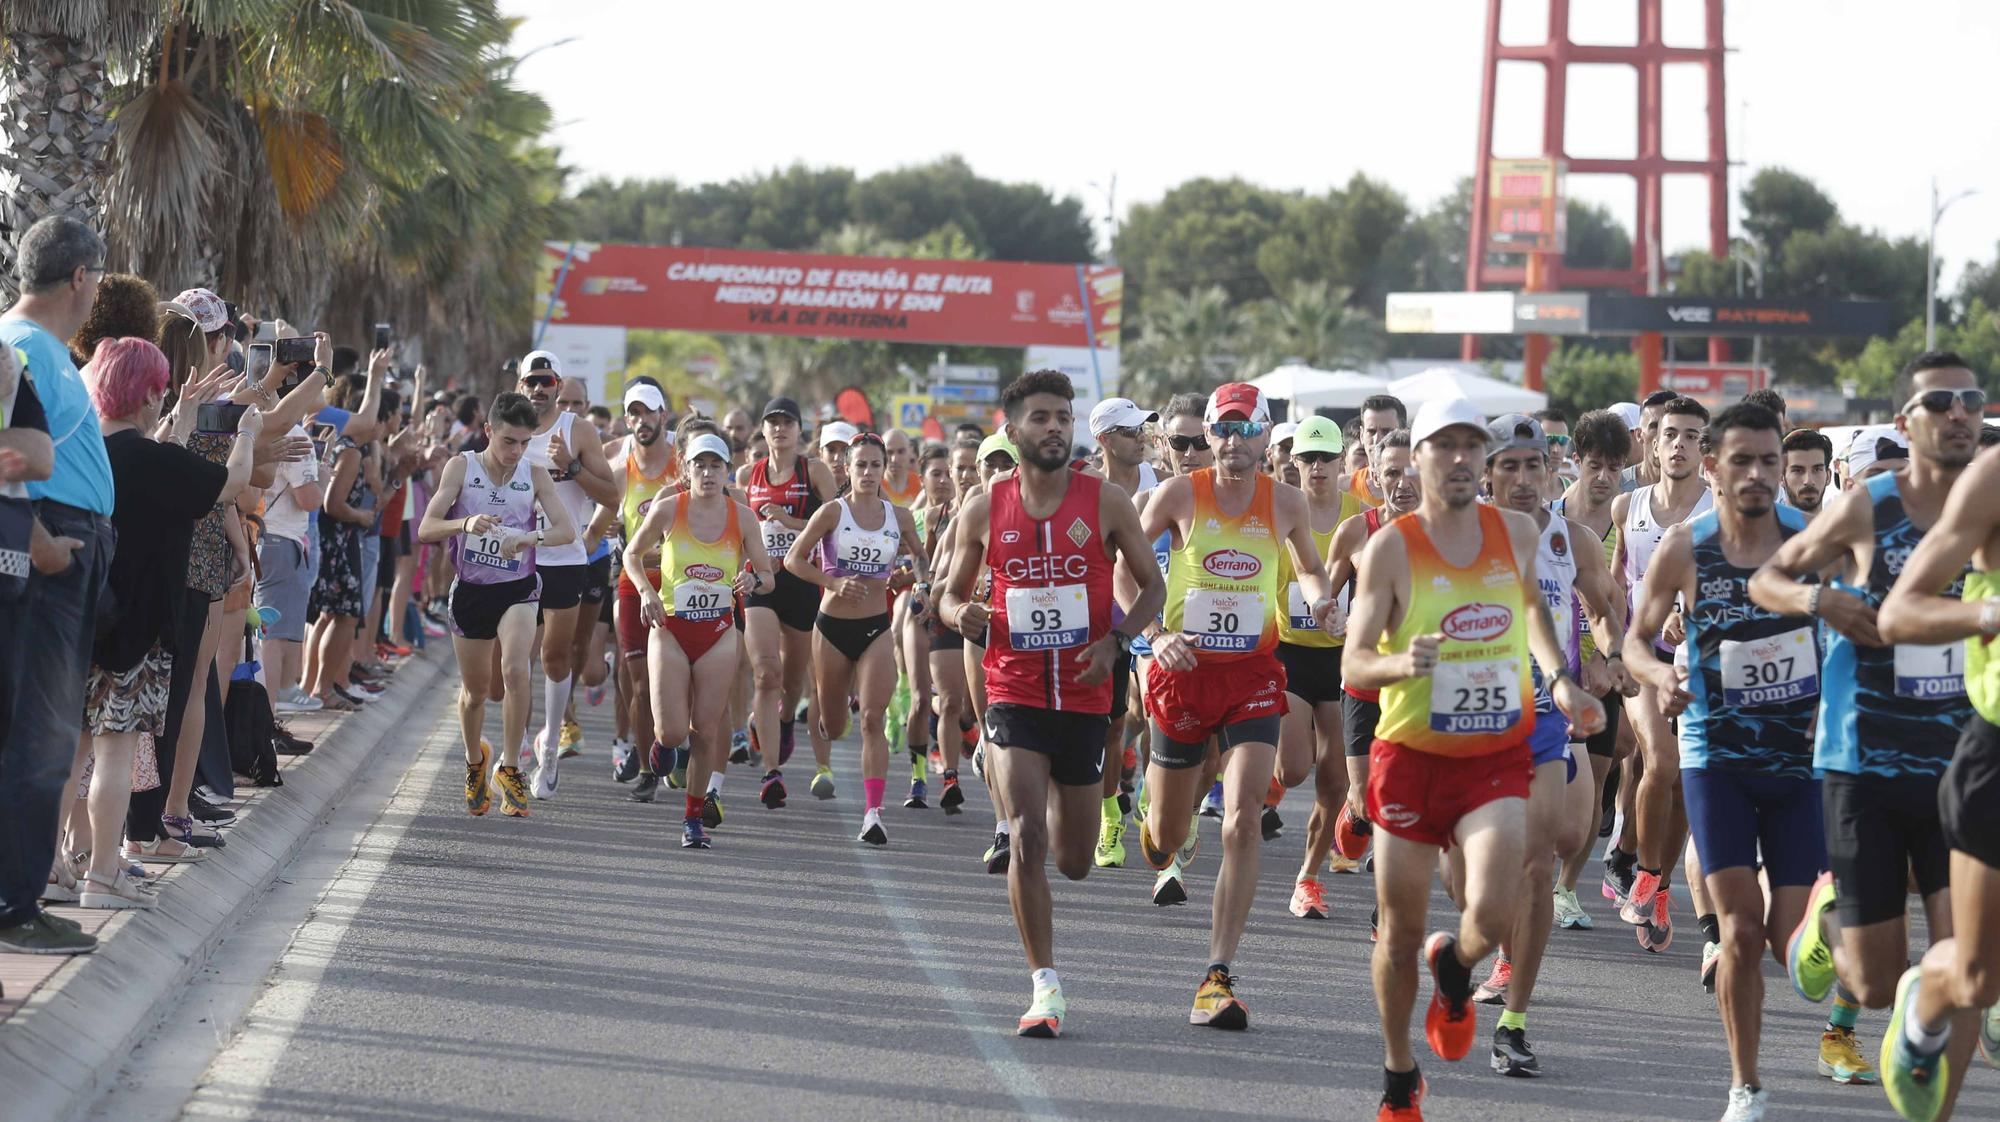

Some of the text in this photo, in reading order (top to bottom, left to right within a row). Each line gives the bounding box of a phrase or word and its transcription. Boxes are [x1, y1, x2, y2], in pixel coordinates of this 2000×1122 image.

[667, 262, 992, 294] CAMPEONATO DE ESPAÑA DE RUTA
[715, 285, 777, 304] MEDIO
[780, 287, 879, 310] MARATÓN
[882, 292, 900, 310] Y
[749, 308, 908, 328] VILA DE PATERNA
[1717, 309, 1810, 322] PATERNA
[767, 532, 796, 548] 389
[850, 546, 881, 562] 392
[1209, 557, 1257, 571] Serrano
[686, 594, 720, 609] 407
[1031, 609, 1062, 631] 93
[1208, 612, 1239, 633] 30
[1451, 615, 1508, 634] Serrano
[1743, 657, 1795, 687] 307
[1454, 687, 1507, 712] 235
